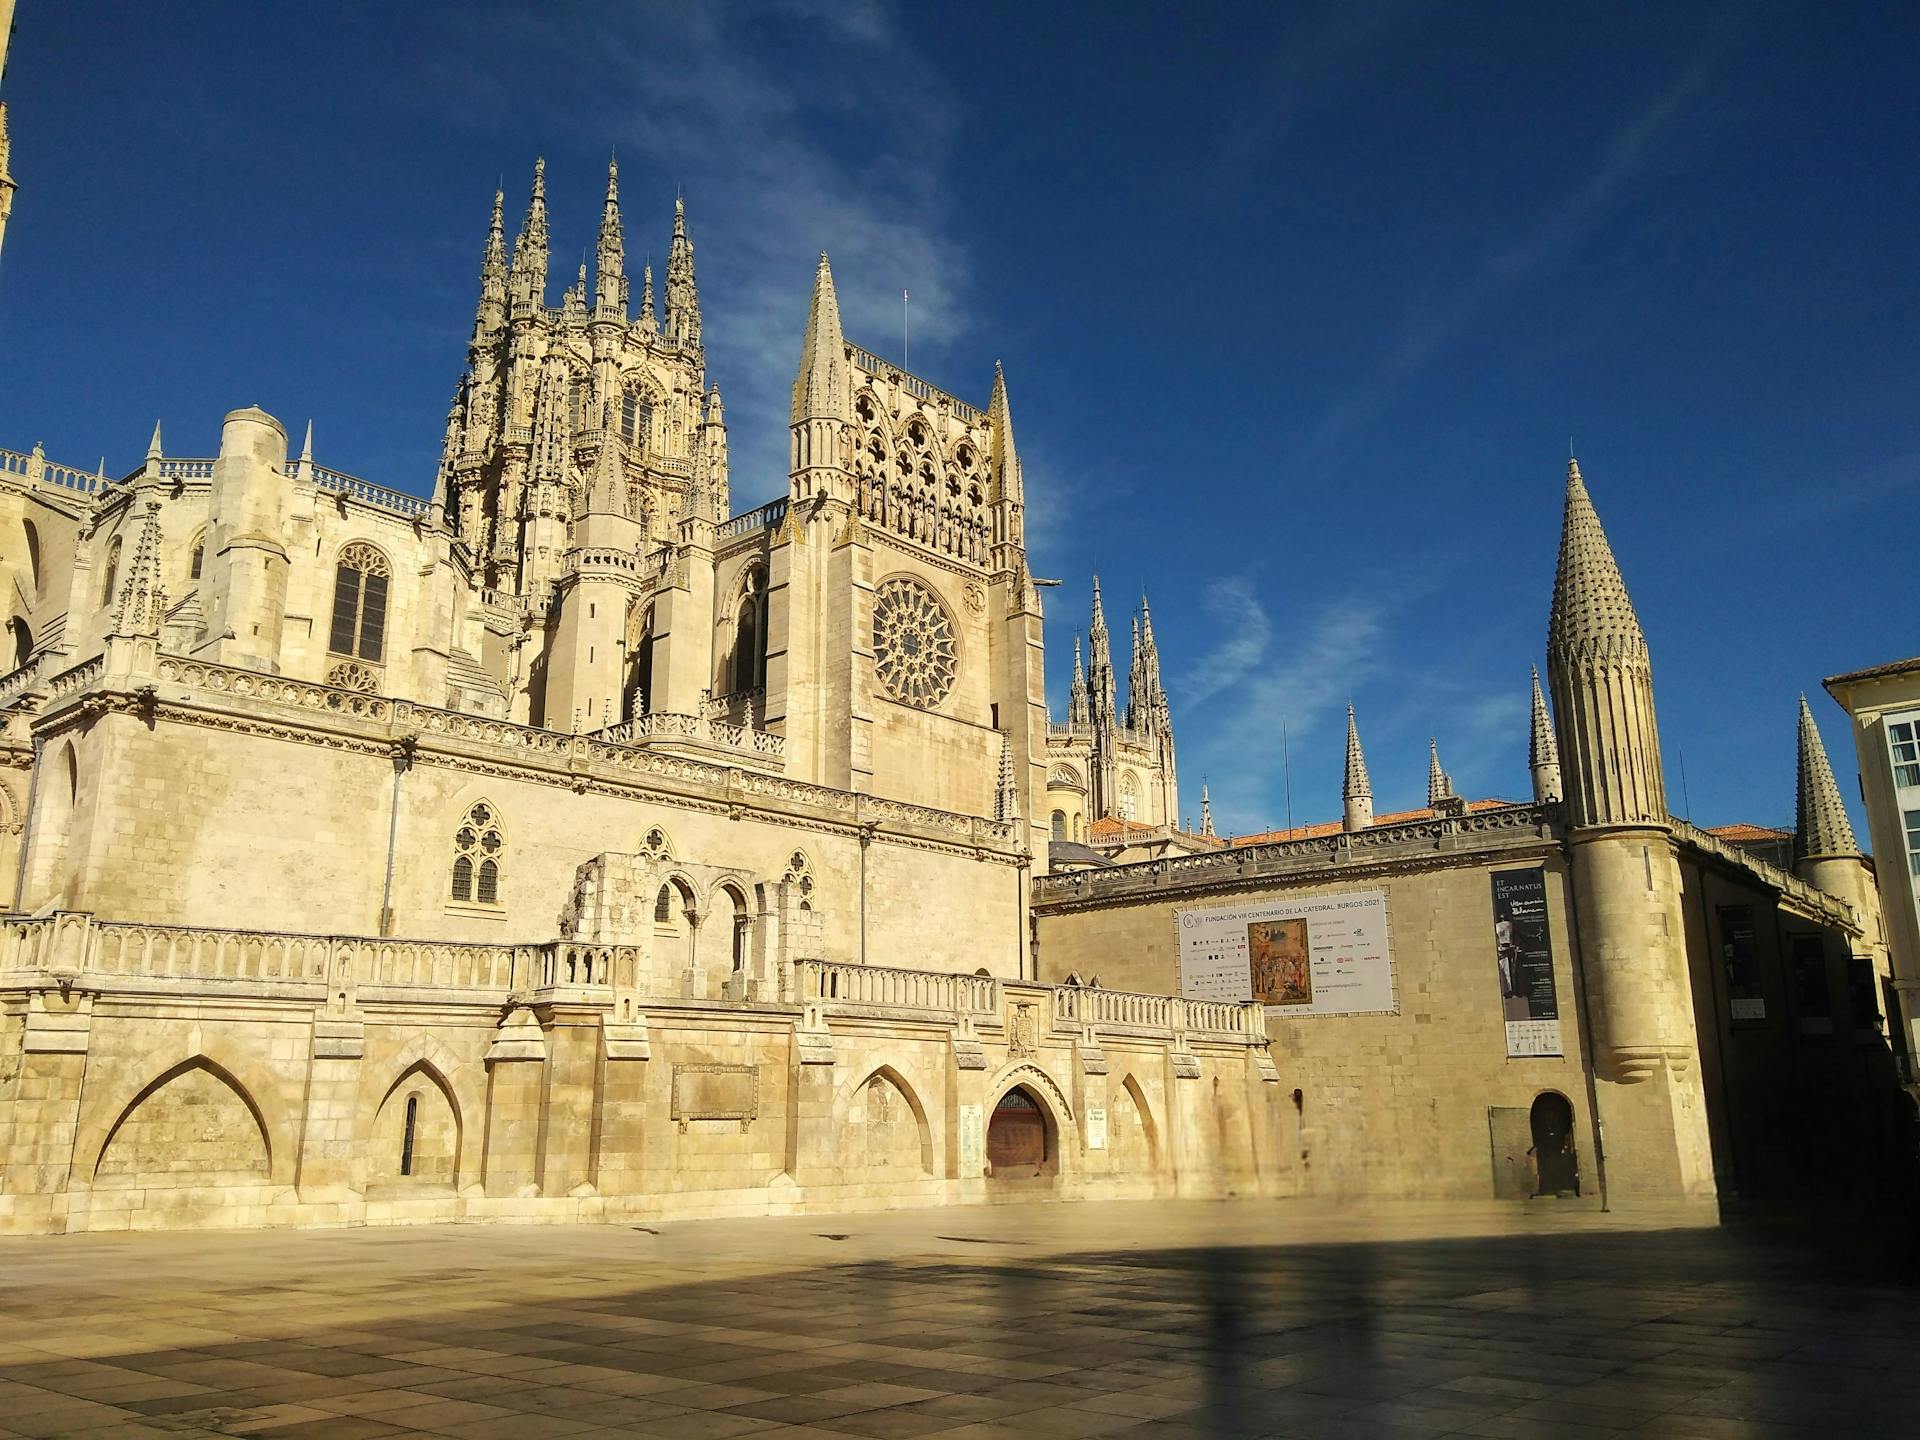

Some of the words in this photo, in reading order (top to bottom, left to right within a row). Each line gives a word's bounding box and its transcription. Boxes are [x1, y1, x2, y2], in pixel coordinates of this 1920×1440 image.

[1497, 883, 1542, 893] INCARNATUS
[1205, 913, 1237, 922] FUNDACIÓN
[1248, 909, 1284, 919] CENTENARIO
[1336, 901, 1363, 909] BURGOS
[1364, 898, 1380, 907] 2021
